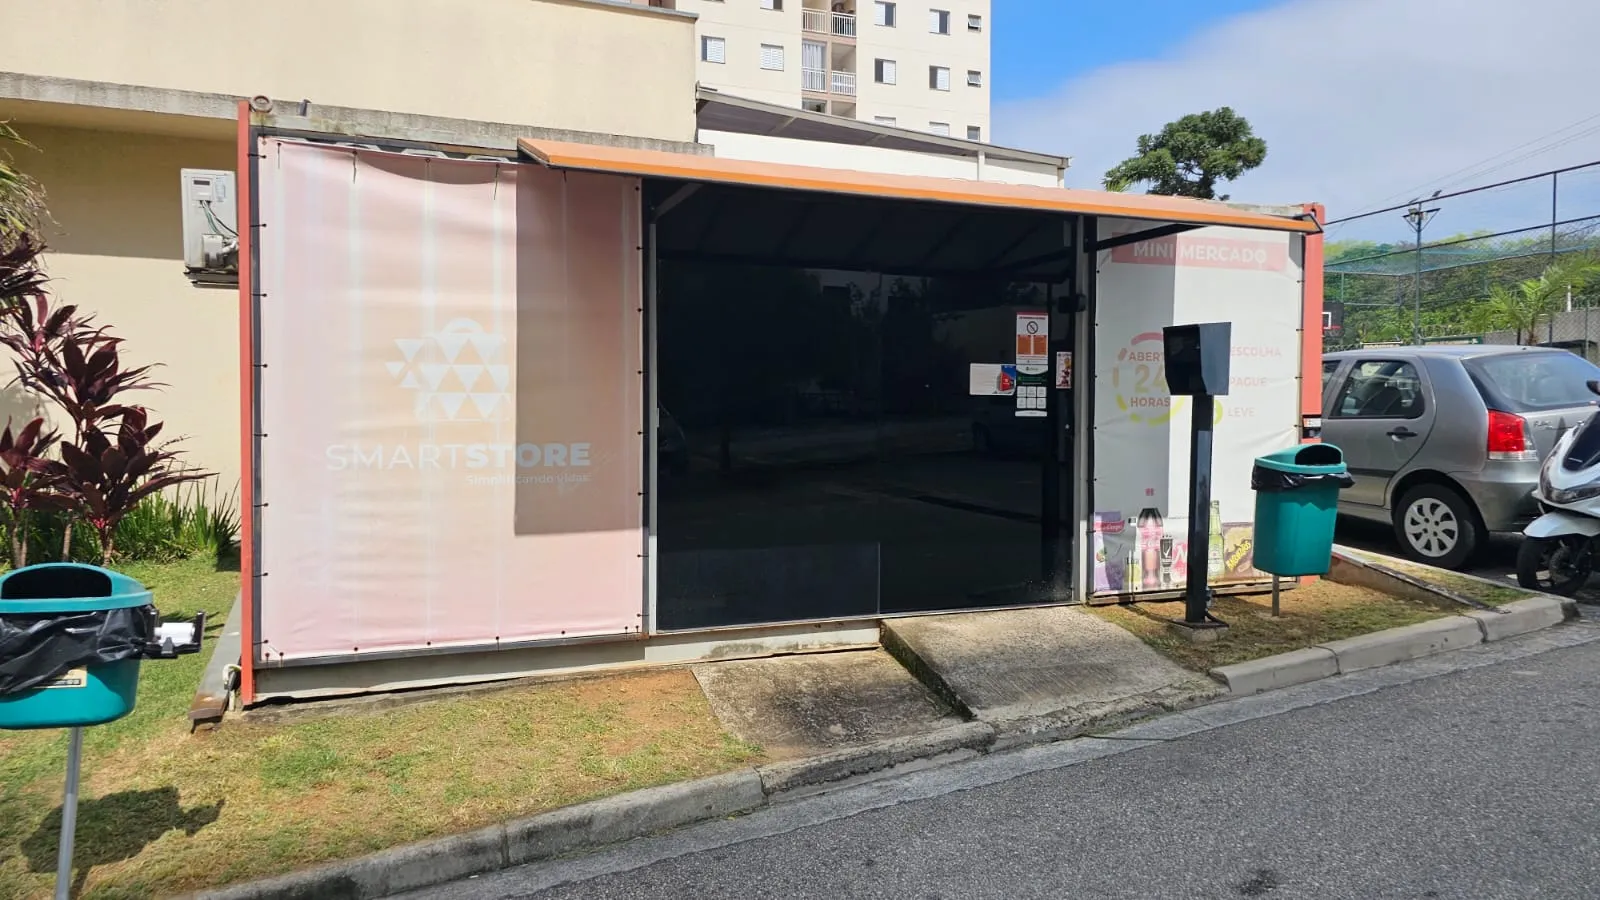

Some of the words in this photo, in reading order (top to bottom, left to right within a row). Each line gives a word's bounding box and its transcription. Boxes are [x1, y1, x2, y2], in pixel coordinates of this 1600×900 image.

[1133, 242, 1174, 258] MINI
[1180, 244, 1268, 264] MERCADO
[1231, 346, 1282, 357] ESCOLHA
[1134, 363, 1168, 394] 24
[1230, 376, 1268, 388] PAGUE
[1130, 396, 1171, 408] HORAS
[1228, 406, 1256, 417] LEVE
